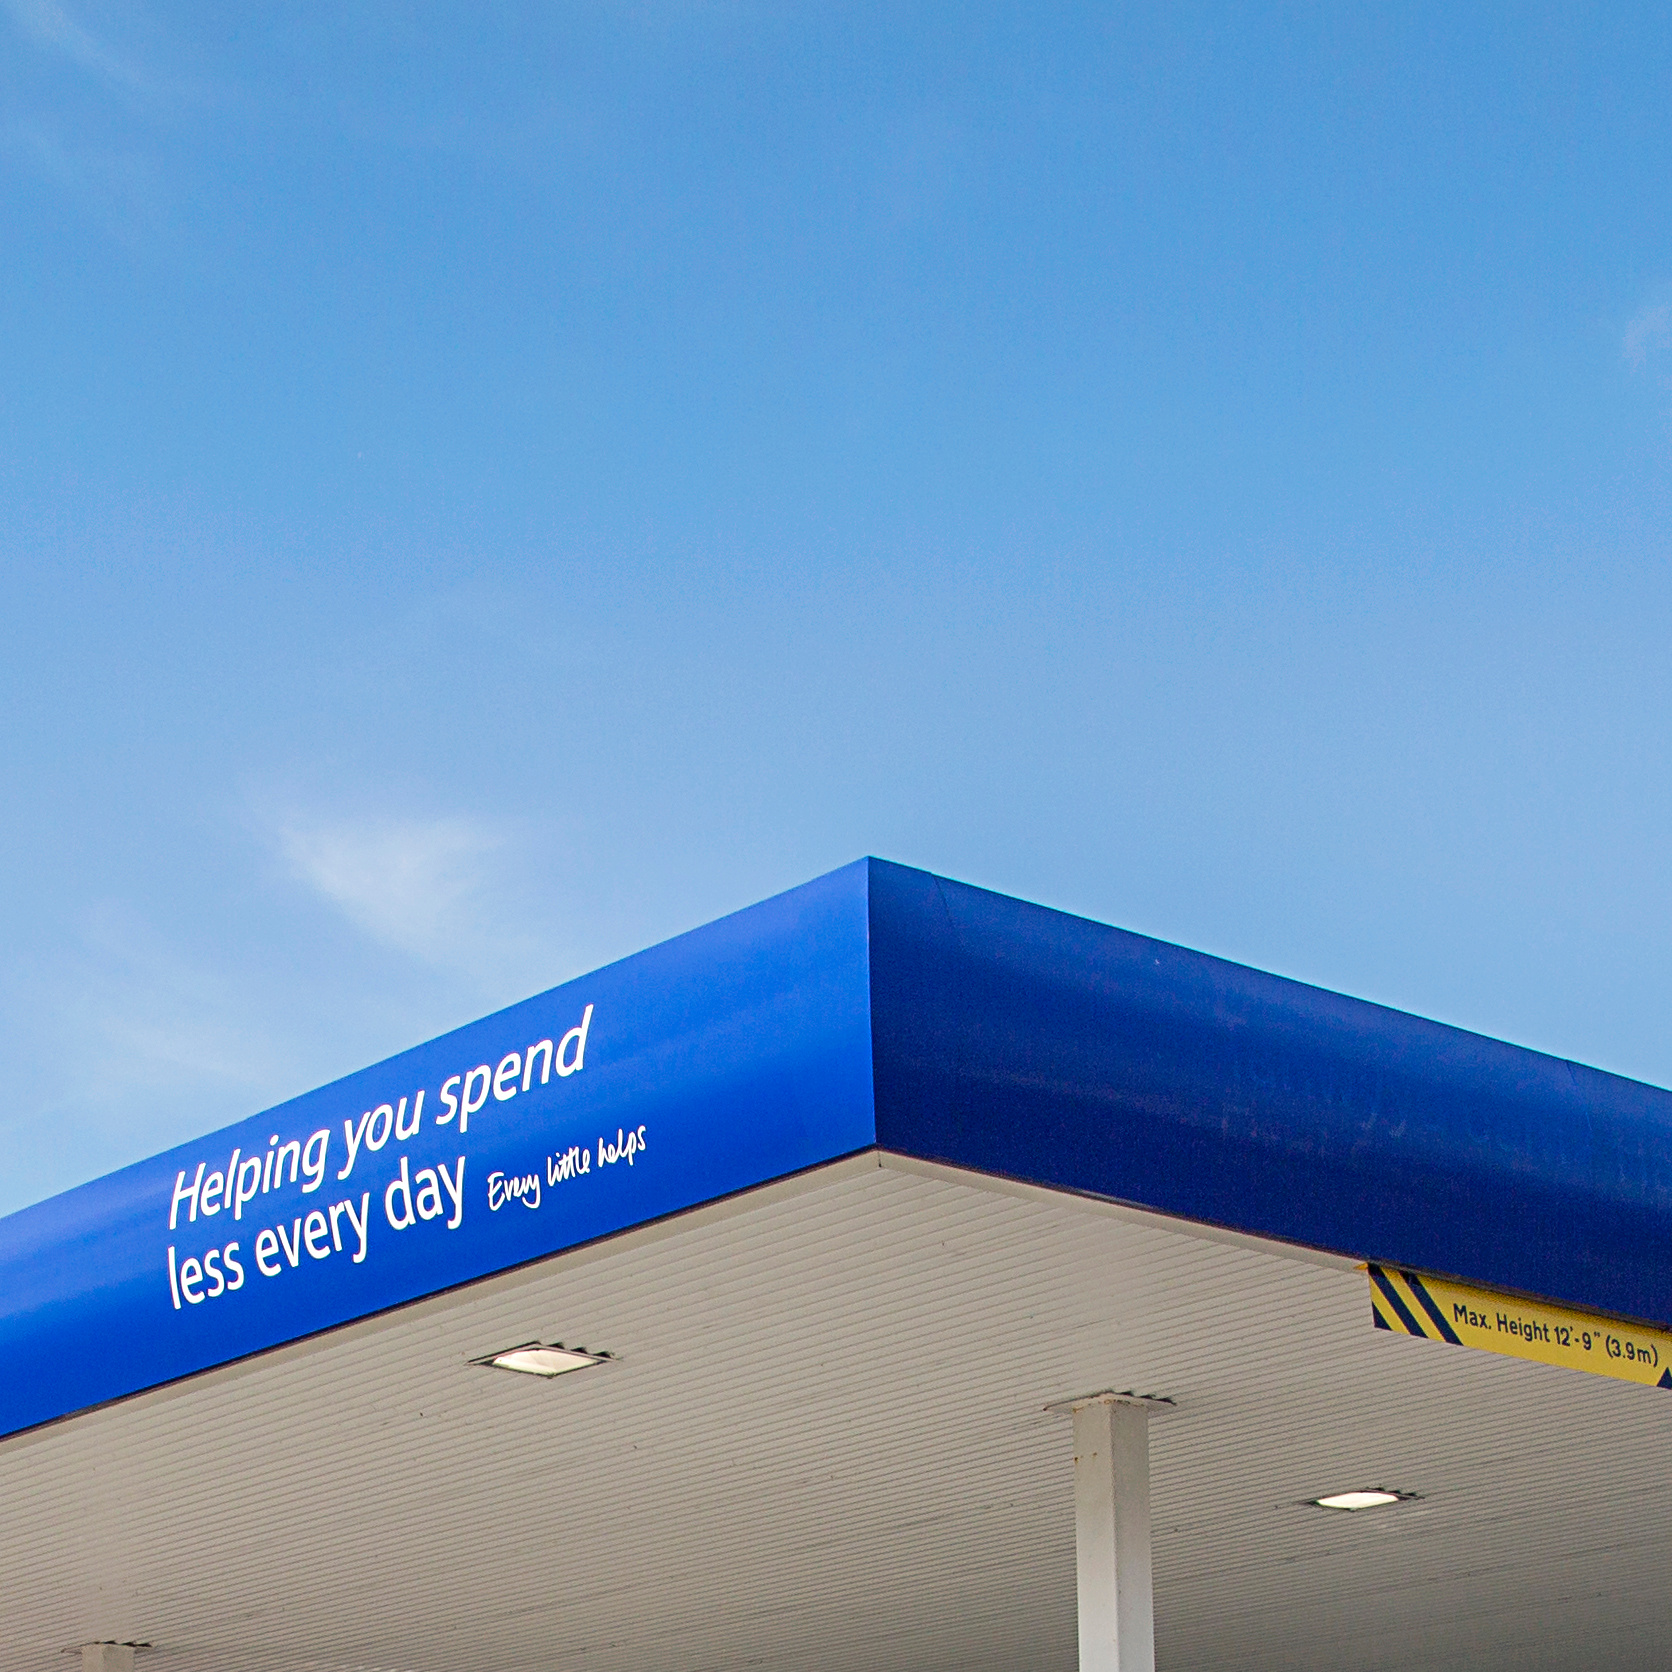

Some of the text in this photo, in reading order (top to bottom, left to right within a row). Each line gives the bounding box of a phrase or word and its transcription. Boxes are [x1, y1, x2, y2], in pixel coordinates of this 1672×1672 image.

[168, 1004, 594, 1231] Helping you spend
[487, 1125, 646, 1211] Every little helps
[168, 1156, 466, 1310] less every day
[1453, 1302, 1491, 1331] Max.
[1496, 1312, 1550, 1343] Height
